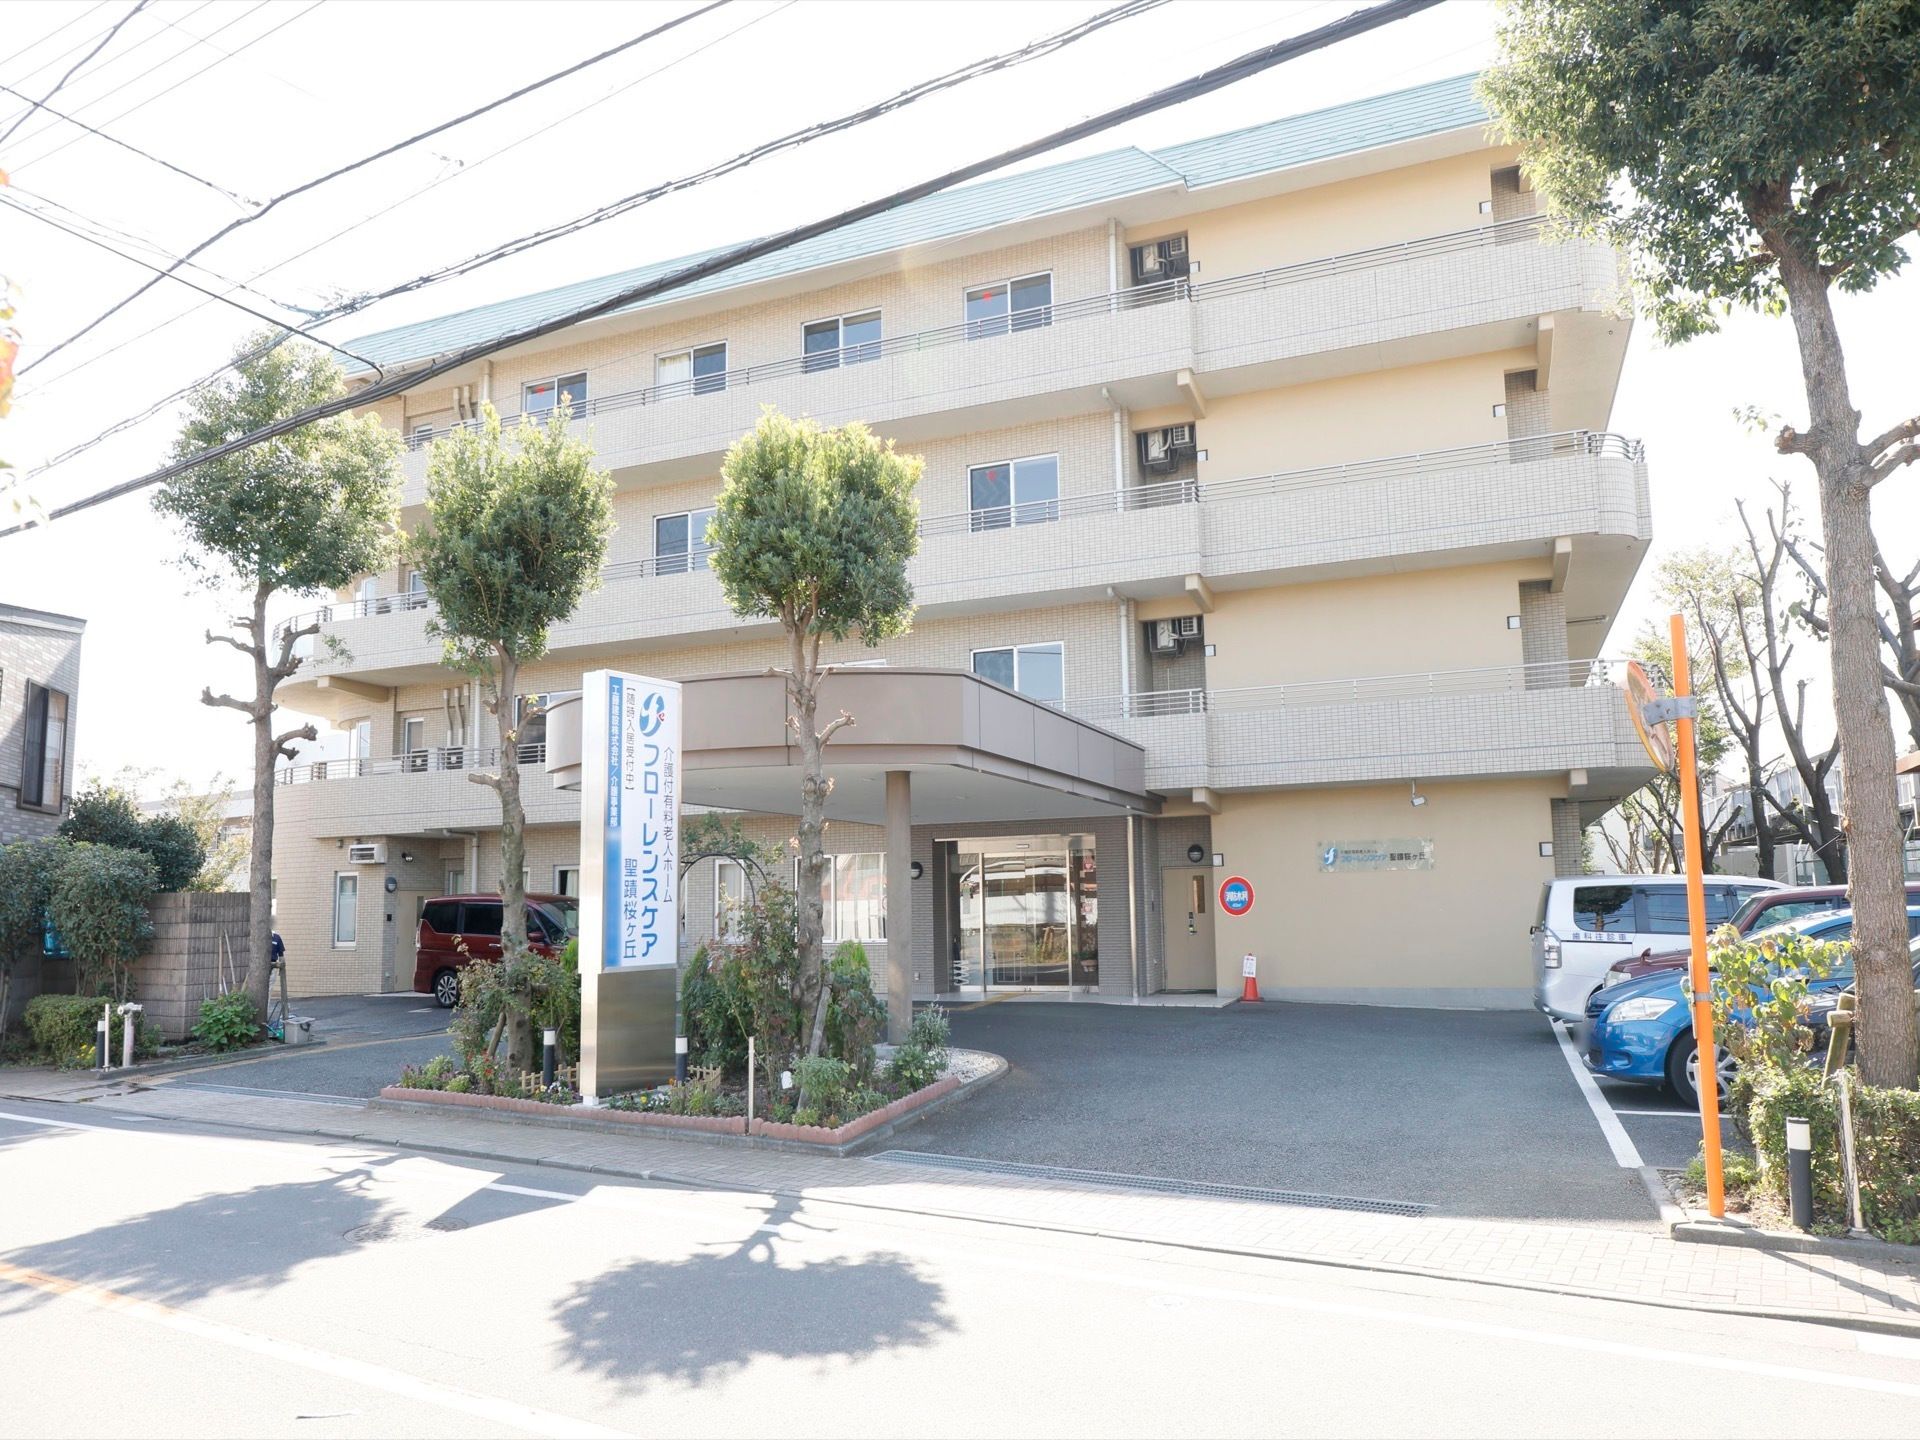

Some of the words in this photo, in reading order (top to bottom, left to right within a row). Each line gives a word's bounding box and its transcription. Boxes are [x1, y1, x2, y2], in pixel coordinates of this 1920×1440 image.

[641, 743, 659, 958] フローレンスケア
[663, 746, 674, 904] 介護付有料老人ホーム
[623, 858, 638, 959] 聖蹟桜ヶ丘
